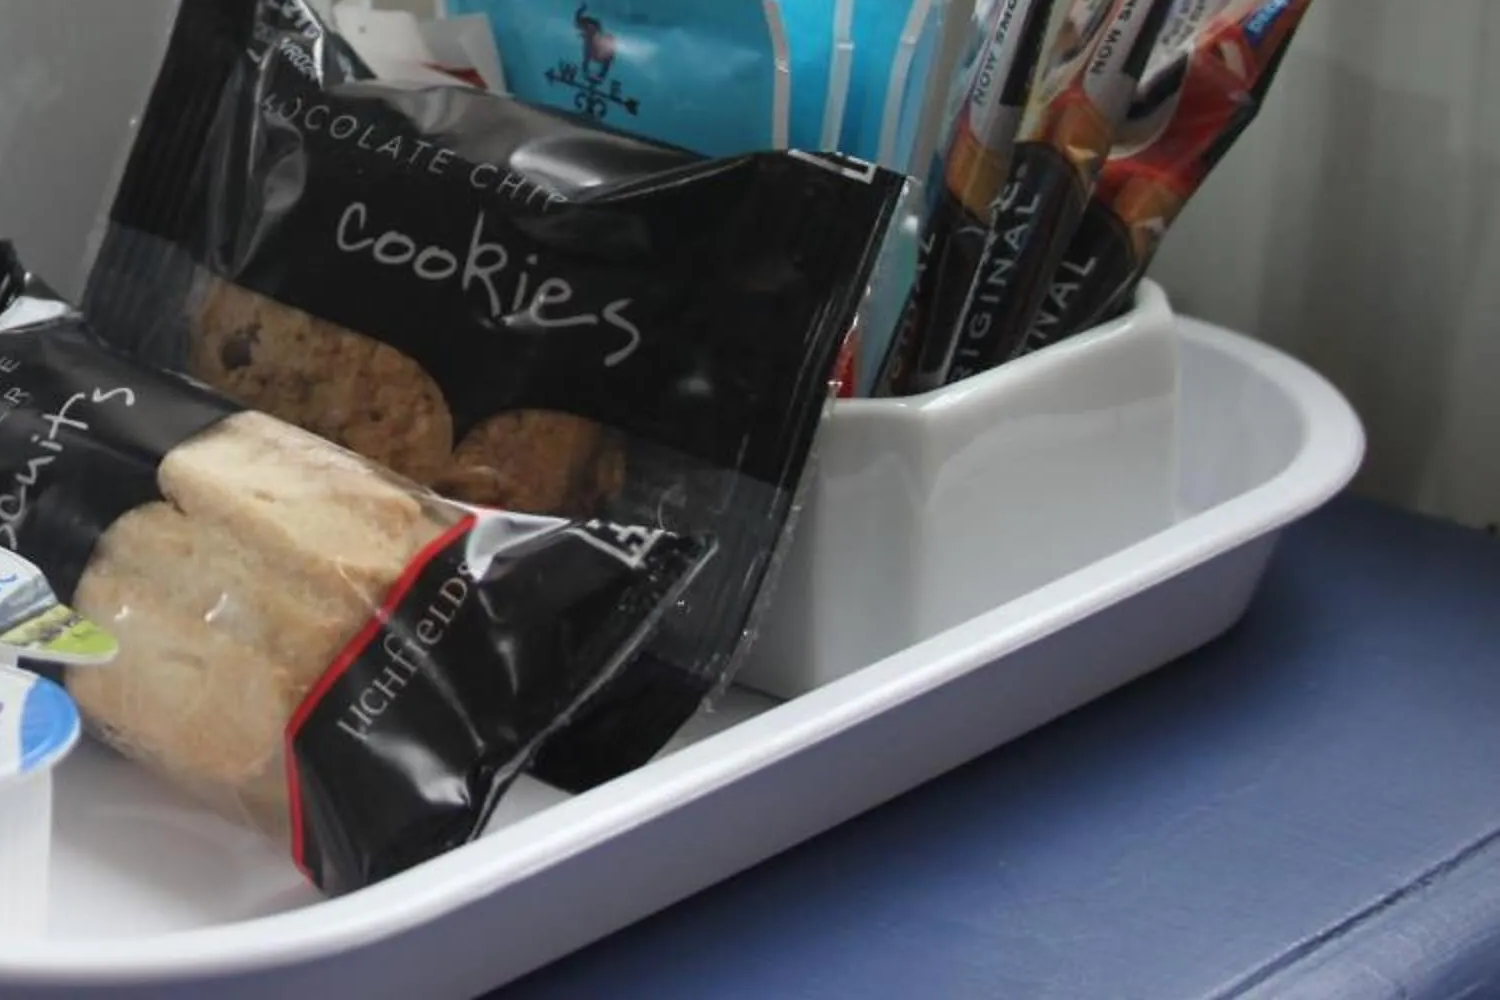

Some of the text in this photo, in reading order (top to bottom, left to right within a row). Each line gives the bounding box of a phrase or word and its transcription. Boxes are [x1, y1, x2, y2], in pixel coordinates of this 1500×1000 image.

[1091, 28, 1122, 75] NOW
[972, 53, 998, 106] NOW
[258, 93, 570, 212] OCOLATE CHIP
